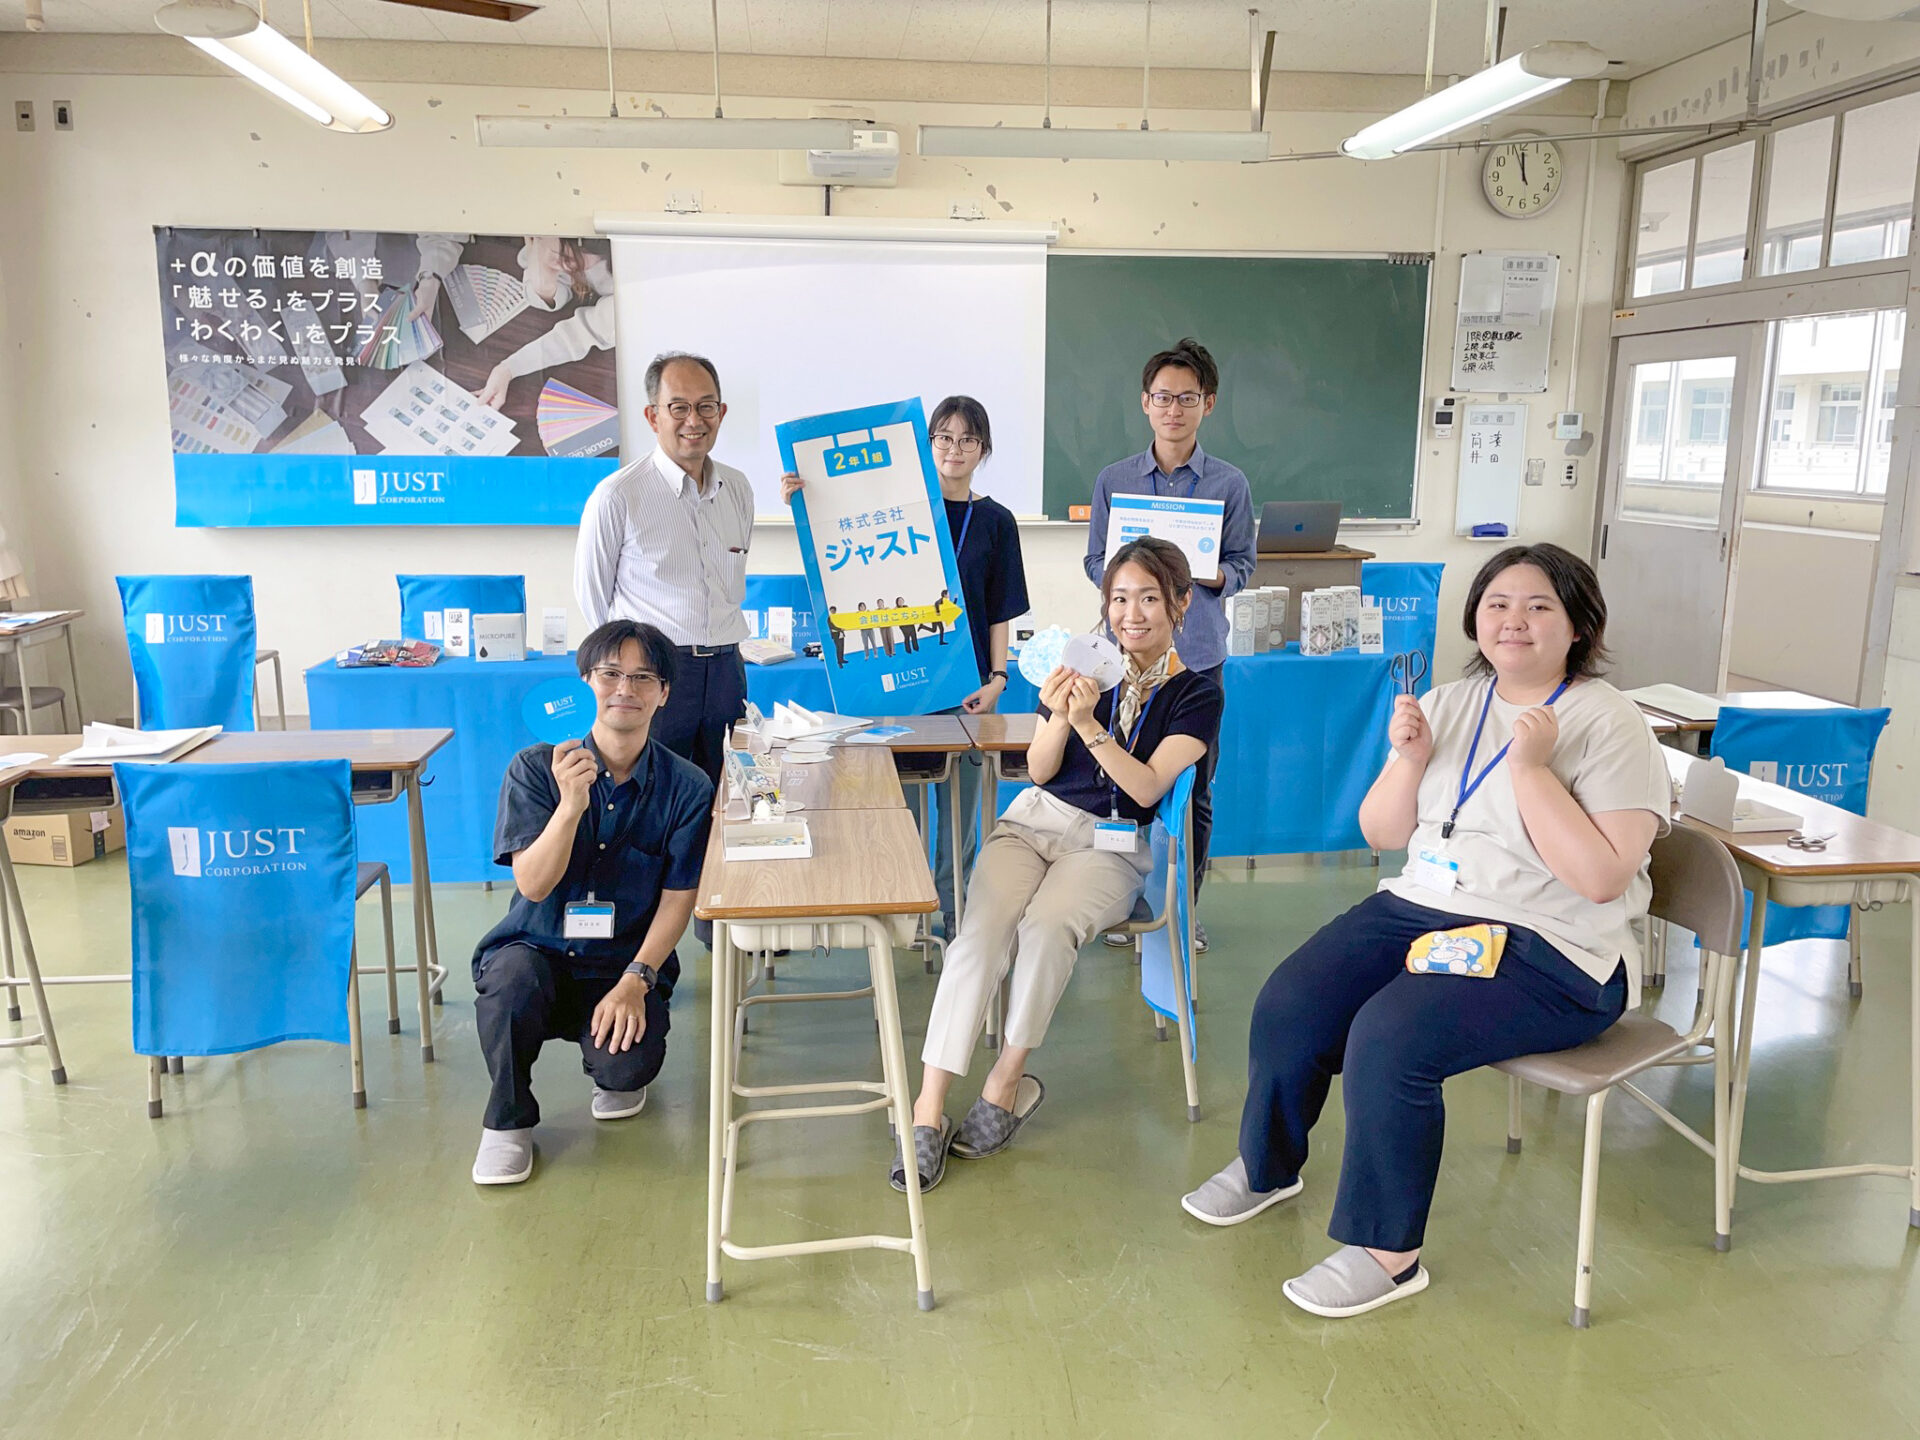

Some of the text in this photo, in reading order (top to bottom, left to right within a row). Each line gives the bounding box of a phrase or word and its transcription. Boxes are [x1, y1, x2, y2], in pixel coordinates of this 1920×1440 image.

[1496, 156, 1506, 167] 10
[1543, 152, 1551, 164] 2
[1492, 171, 1500, 182] 9
[1547, 167, 1554, 178] 3
[1496, 185, 1503, 196] 8
[1543, 182, 1550, 192] 4
[1507, 195, 1514, 206] 7
[1519, 198, 1527, 209] 6
[1533, 193, 1541, 205] 5
[170, 250, 384, 280] +αの価値を創造
[172, 285, 383, 313] 「魅せる」をプラス
[175, 317, 402, 346] 「わくわく」をプラス
[833, 447, 884, 470] 2年1組
[380, 472, 445, 496] JUST
[379, 496, 445, 504] CORPORATION
[1151, 502, 1185, 511] MISSION
[838, 506, 905, 533] 株式会社
[825, 526, 931, 572] ジャスト
[1379, 597, 1421, 612] JUST
[167, 614, 227, 636] JUST
[479, 632, 516, 640] MICROPURE
[895, 666, 927, 685] JUST
[553, 695, 574, 709] JUST
[1785, 763, 1849, 788] JUST
[13, 828, 46, 838] amazon
[206, 827, 306, 866] JUST
[205, 862, 307, 877] CORPORATION
